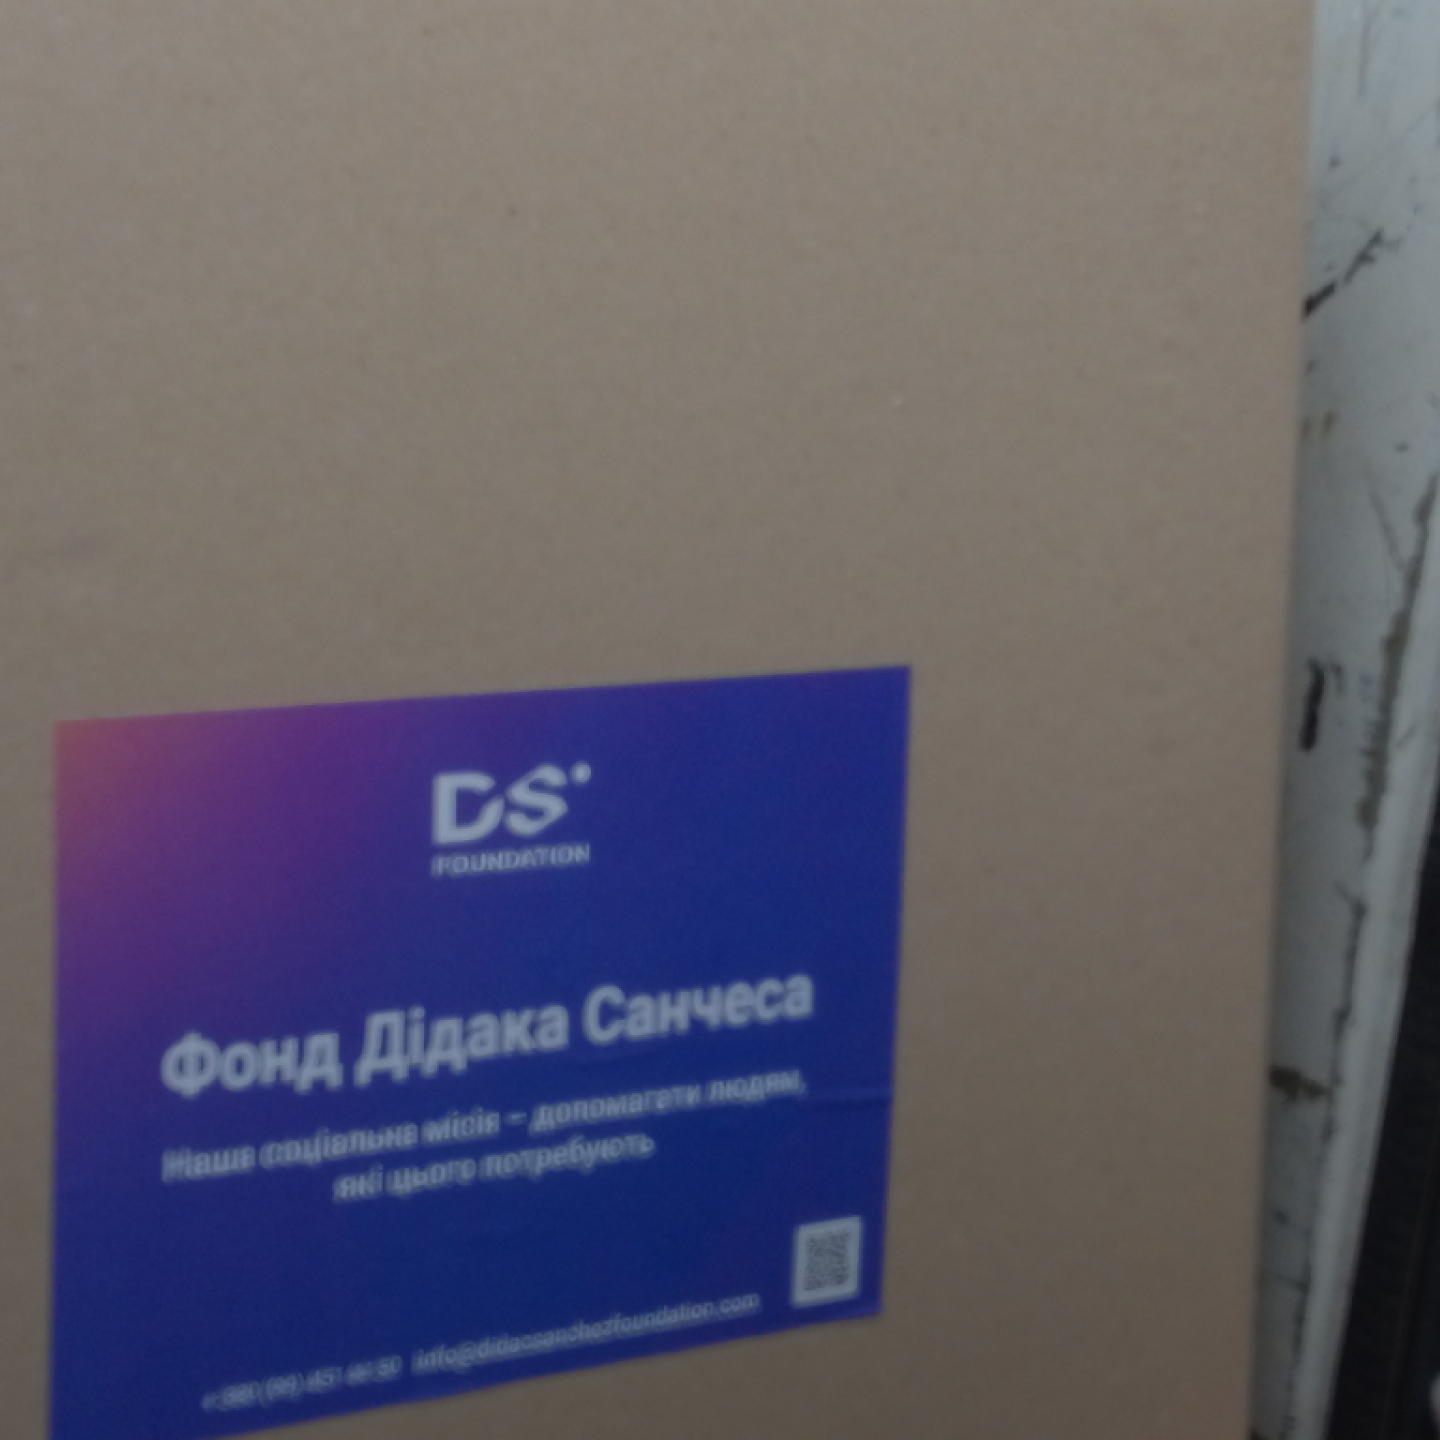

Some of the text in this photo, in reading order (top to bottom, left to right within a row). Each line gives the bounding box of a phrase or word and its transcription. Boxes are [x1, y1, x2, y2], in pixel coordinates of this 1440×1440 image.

[435, 765, 591, 845] DS
[433, 841, 591, 878] FOUNDATION
[160, 975, 813, 1097] Фонд Дідака Санчеса
[259, 1127, 418, 1170] соціальна
[421, 1107, 502, 1149] місія
[527, 1082, 700, 1138] допомагати
[331, 1134, 657, 1203] які цього потребують
